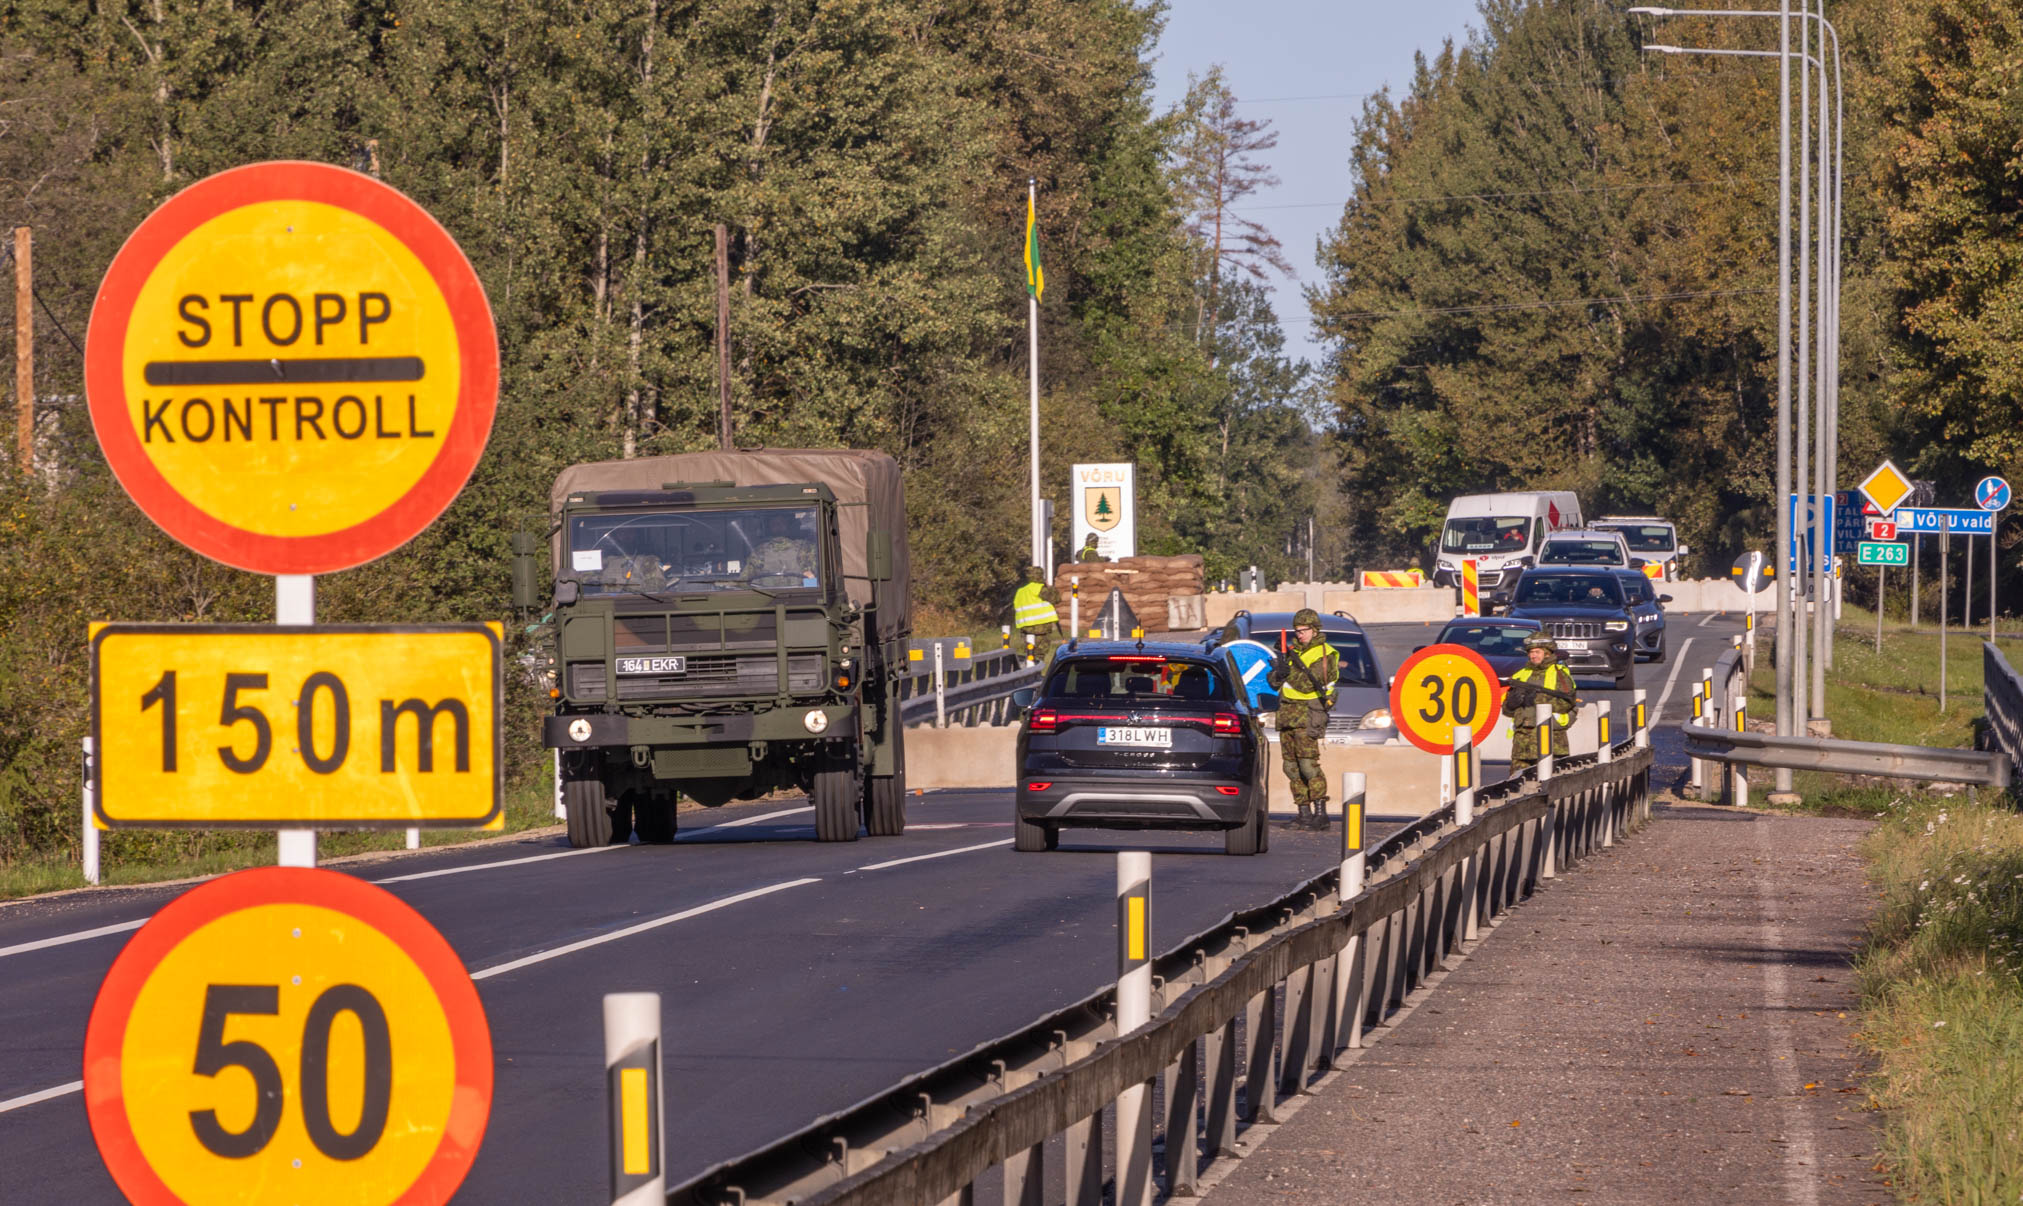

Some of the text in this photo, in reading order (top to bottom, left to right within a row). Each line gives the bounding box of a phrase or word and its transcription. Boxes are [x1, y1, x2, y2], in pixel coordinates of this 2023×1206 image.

[177, 292, 392, 348] STOPP
[144, 395, 435, 443] KONTROLL
[1081, 468, 1125, 482] VÕRU
[1881, 525, 1889, 537] 2
[1962, 516, 1992, 529] vald
[1863, 547, 1904, 561] E 263
[652, 659, 677, 670] EKR
[1419, 675, 1478, 725] 30
[141, 670, 470, 774] 150 m
[188, 983, 392, 1161] 50
